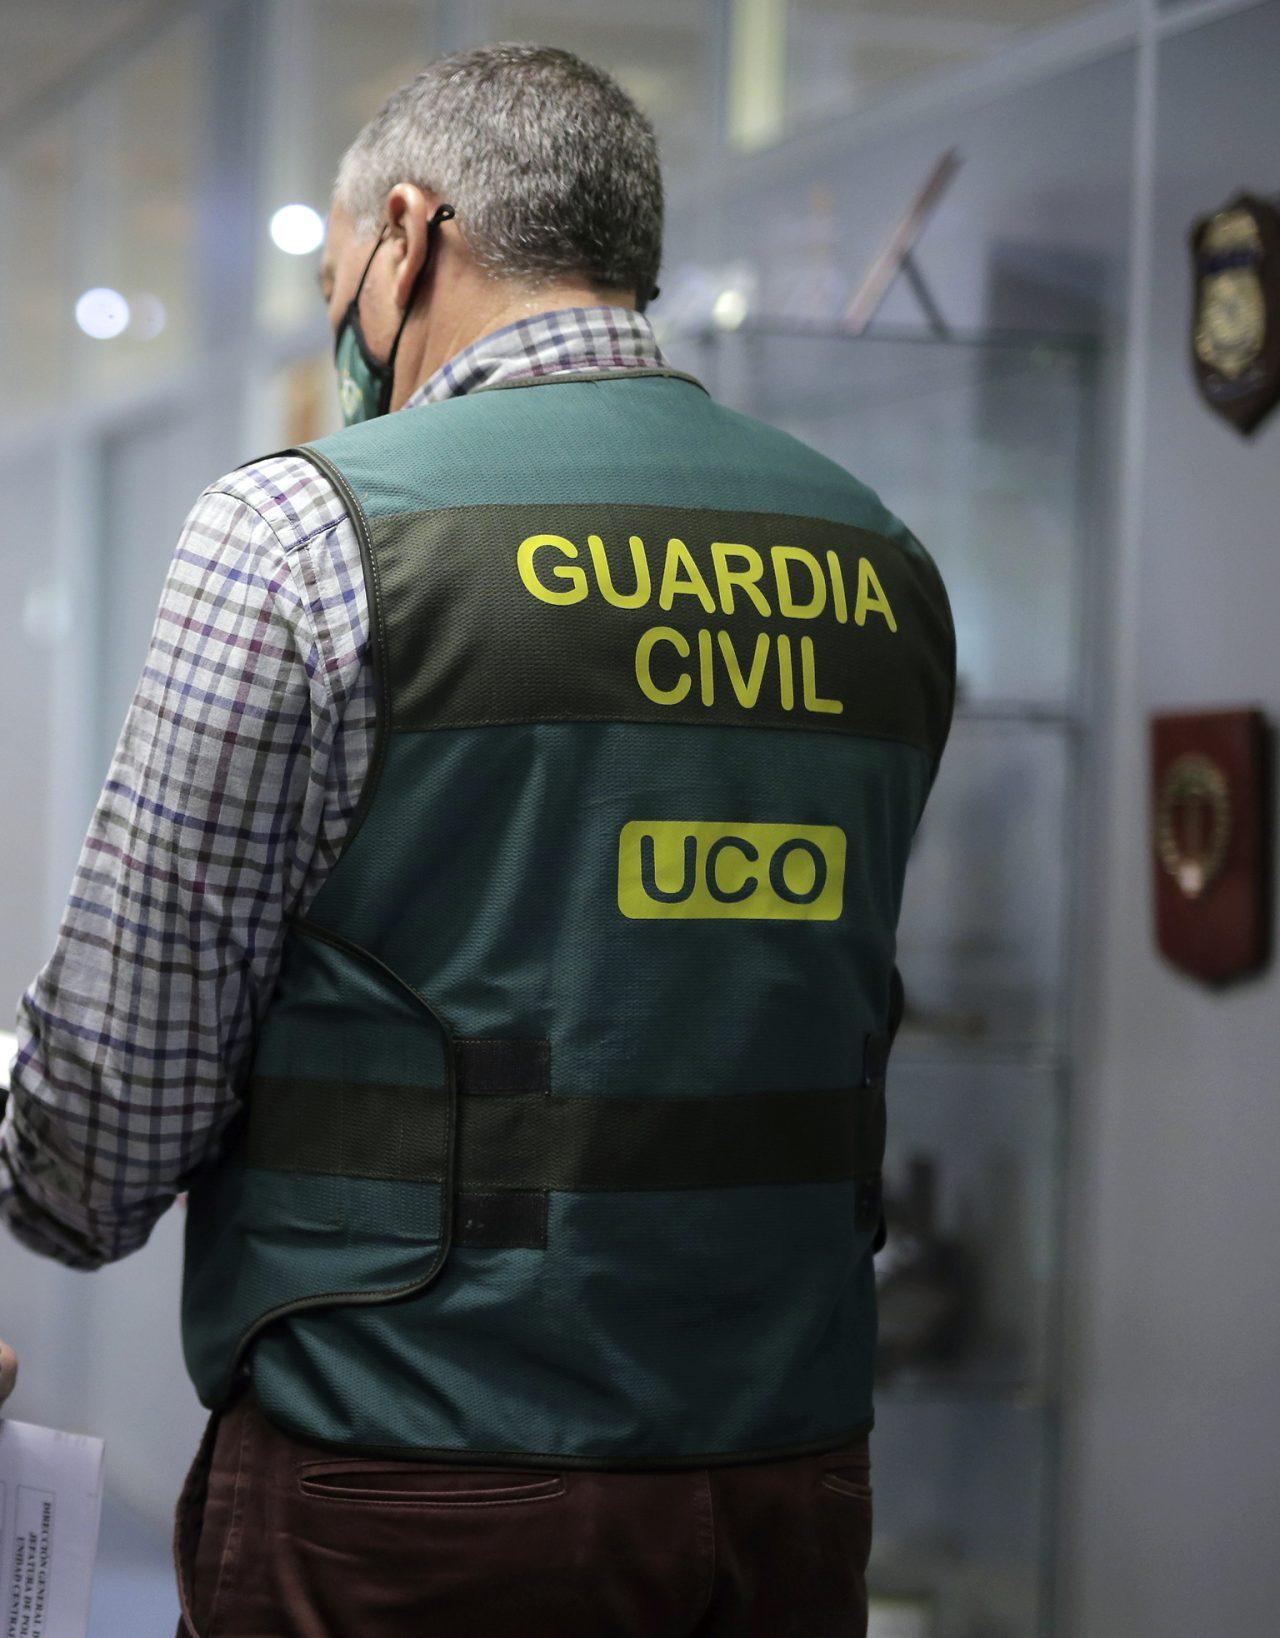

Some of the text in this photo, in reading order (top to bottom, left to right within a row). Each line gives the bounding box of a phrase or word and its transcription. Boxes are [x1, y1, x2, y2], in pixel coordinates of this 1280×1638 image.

[517, 534, 897, 633] GUARDIA
[635, 626, 843, 714] CIVIL
[640, 834, 827, 905] UCO
